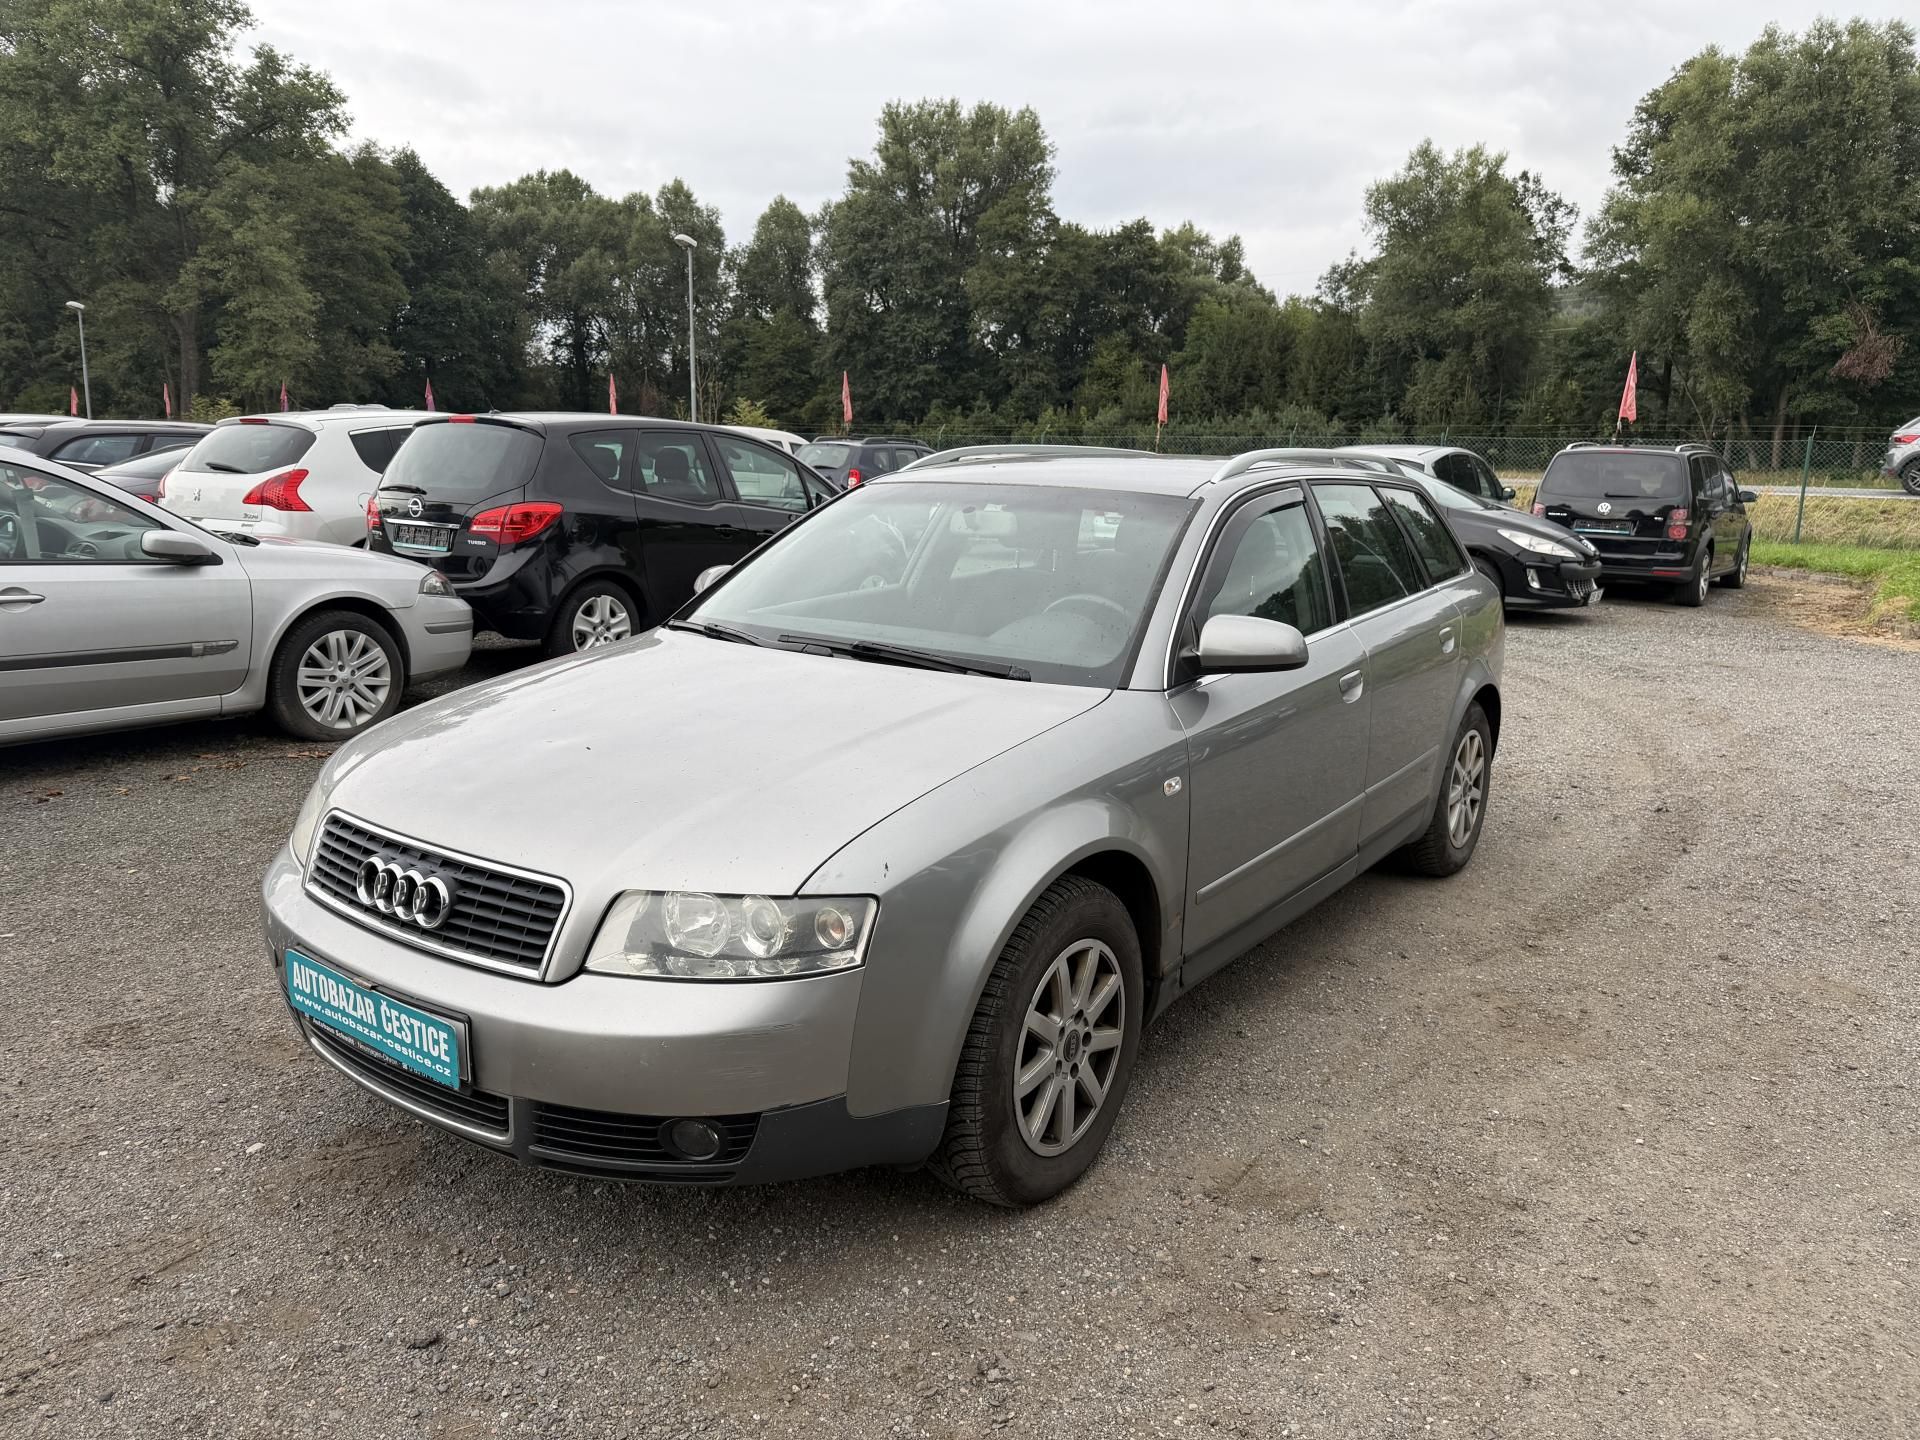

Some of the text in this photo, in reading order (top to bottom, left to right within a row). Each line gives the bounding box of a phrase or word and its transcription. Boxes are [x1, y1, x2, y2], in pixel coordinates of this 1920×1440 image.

[293, 961, 451, 1063] AUTOBAZAR ČESTICE
[294, 992, 451, 1077] www.autobazar-cestice.cz
